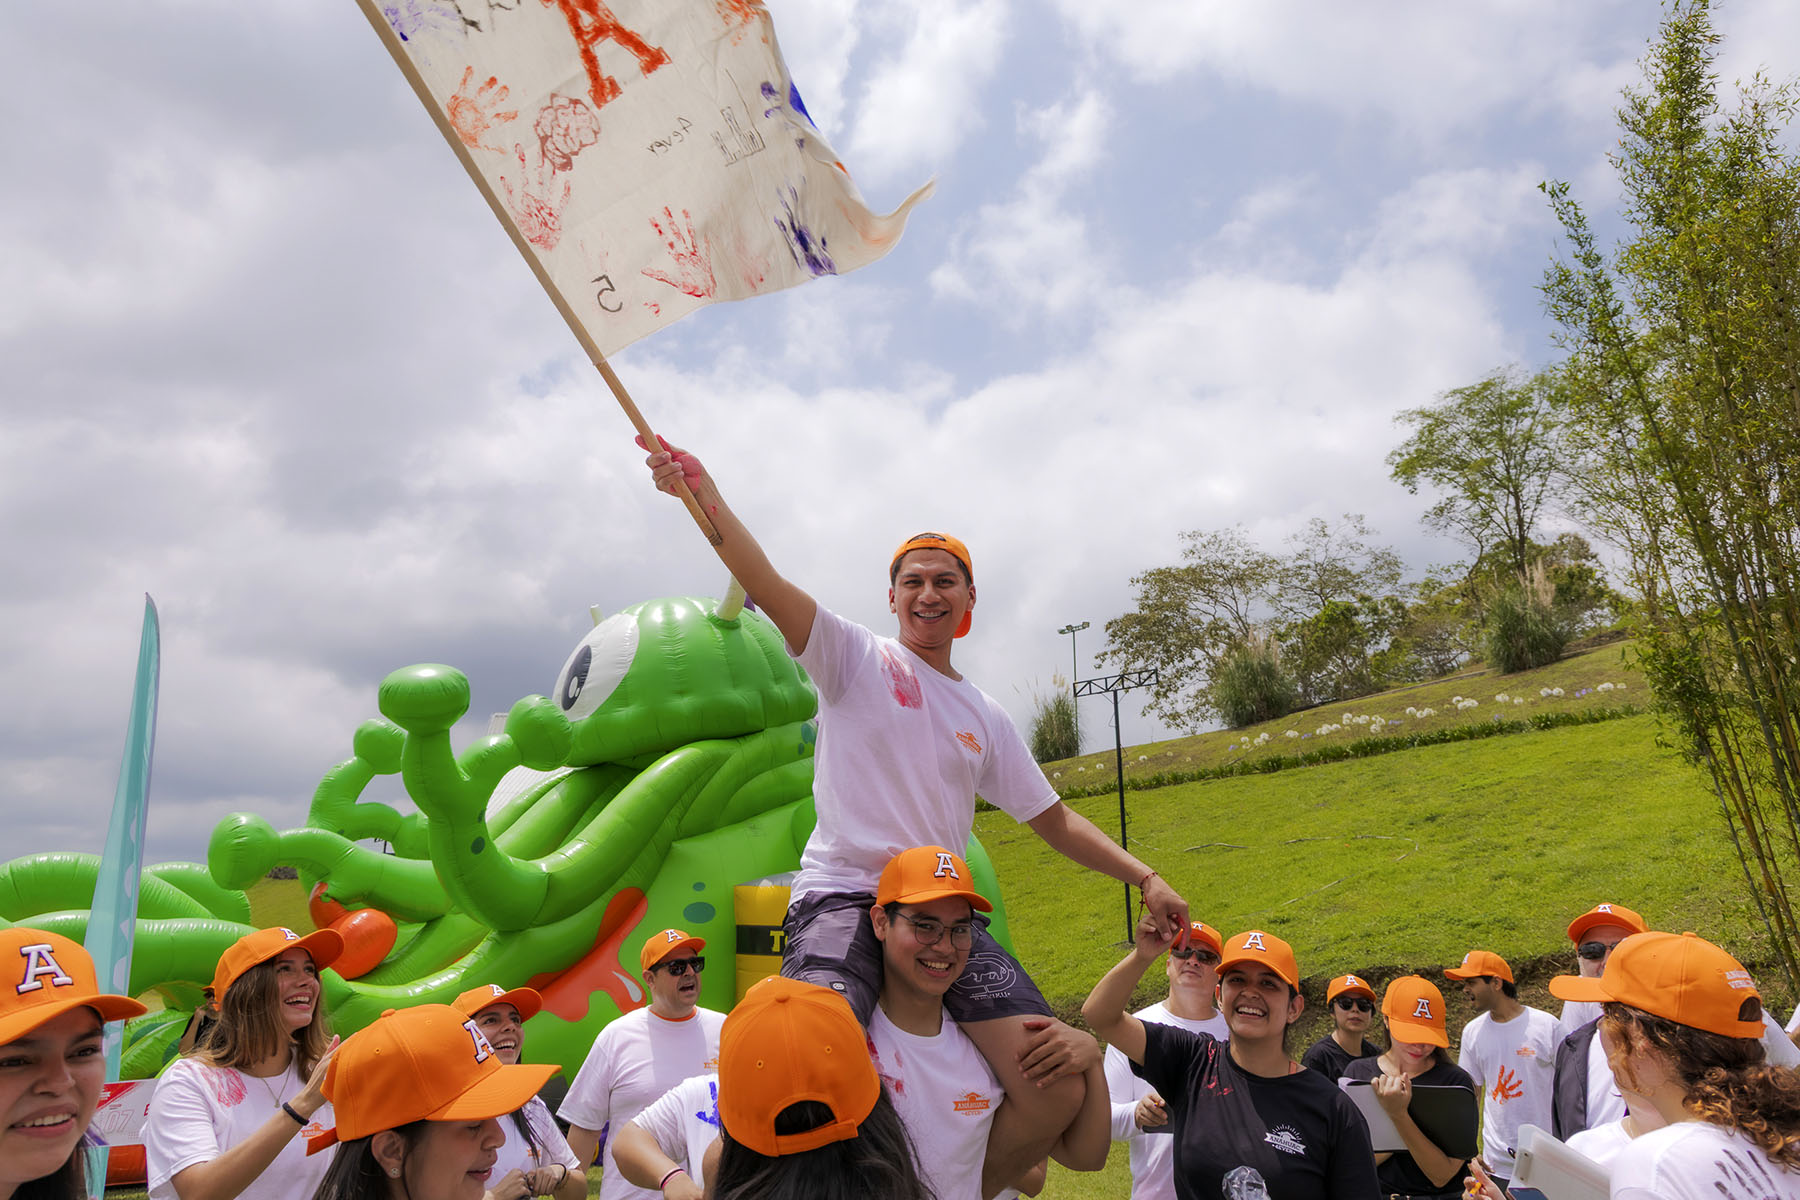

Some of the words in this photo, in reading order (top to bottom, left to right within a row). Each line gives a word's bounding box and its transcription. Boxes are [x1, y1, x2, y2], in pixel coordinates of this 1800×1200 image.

[538, 0, 673, 111] A
[934, 853, 960, 880] A
[280, 927, 301, 940] A
[665, 929, 683, 943] A
[1242, 932, 1267, 952] A
[16, 944, 74, 996] A
[488, 983, 507, 996] A
[1345, 975, 1360, 986] A
[1412, 998, 1433, 1019] A
[462, 1019, 496, 1064] A
